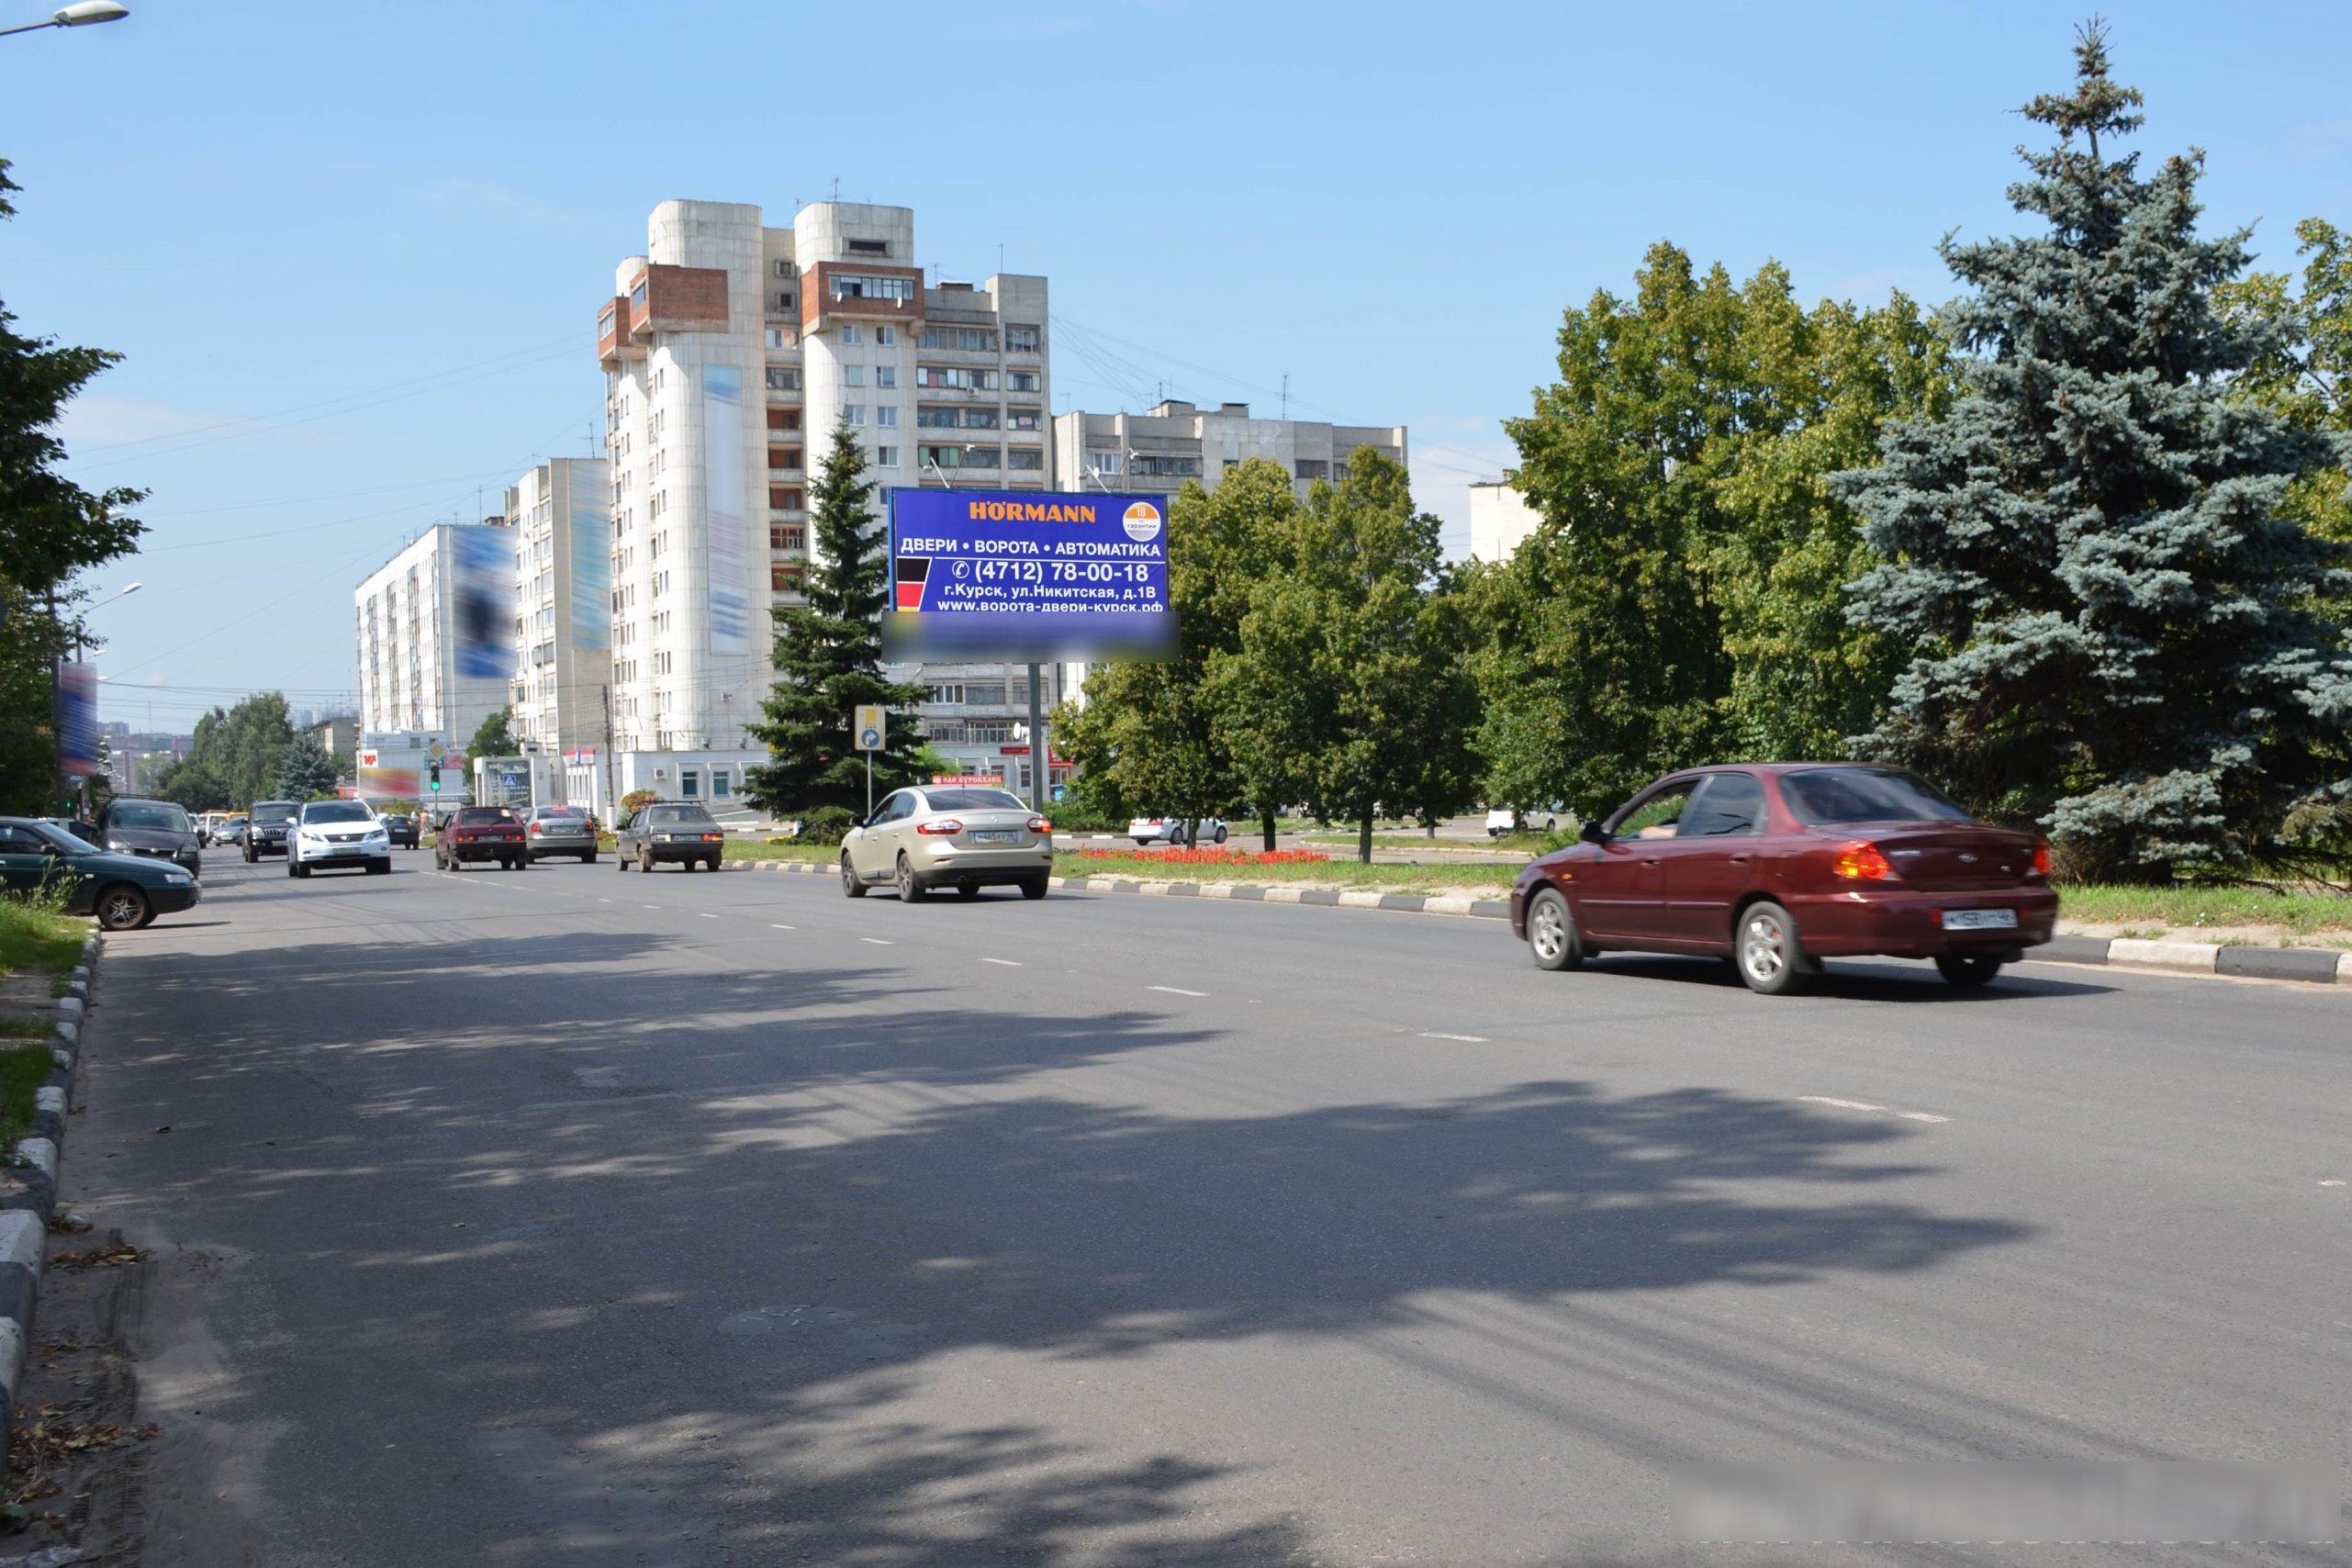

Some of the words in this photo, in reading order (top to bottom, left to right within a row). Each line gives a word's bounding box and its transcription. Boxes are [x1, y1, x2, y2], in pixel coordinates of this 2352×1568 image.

[901, 538, 958, 554] ДВЕРИ
[974, 540, 1039, 554] ВОРОТА
[1055, 543, 1160, 556] АВТОМАТИКА
[975, 560, 1043, 584] (4712)
[1051, 563, 1148, 582] 78-00-18
[944, 583, 1007, 598] г.Курск,
[1011, 585, 1119, 600] ул.Никитская,
